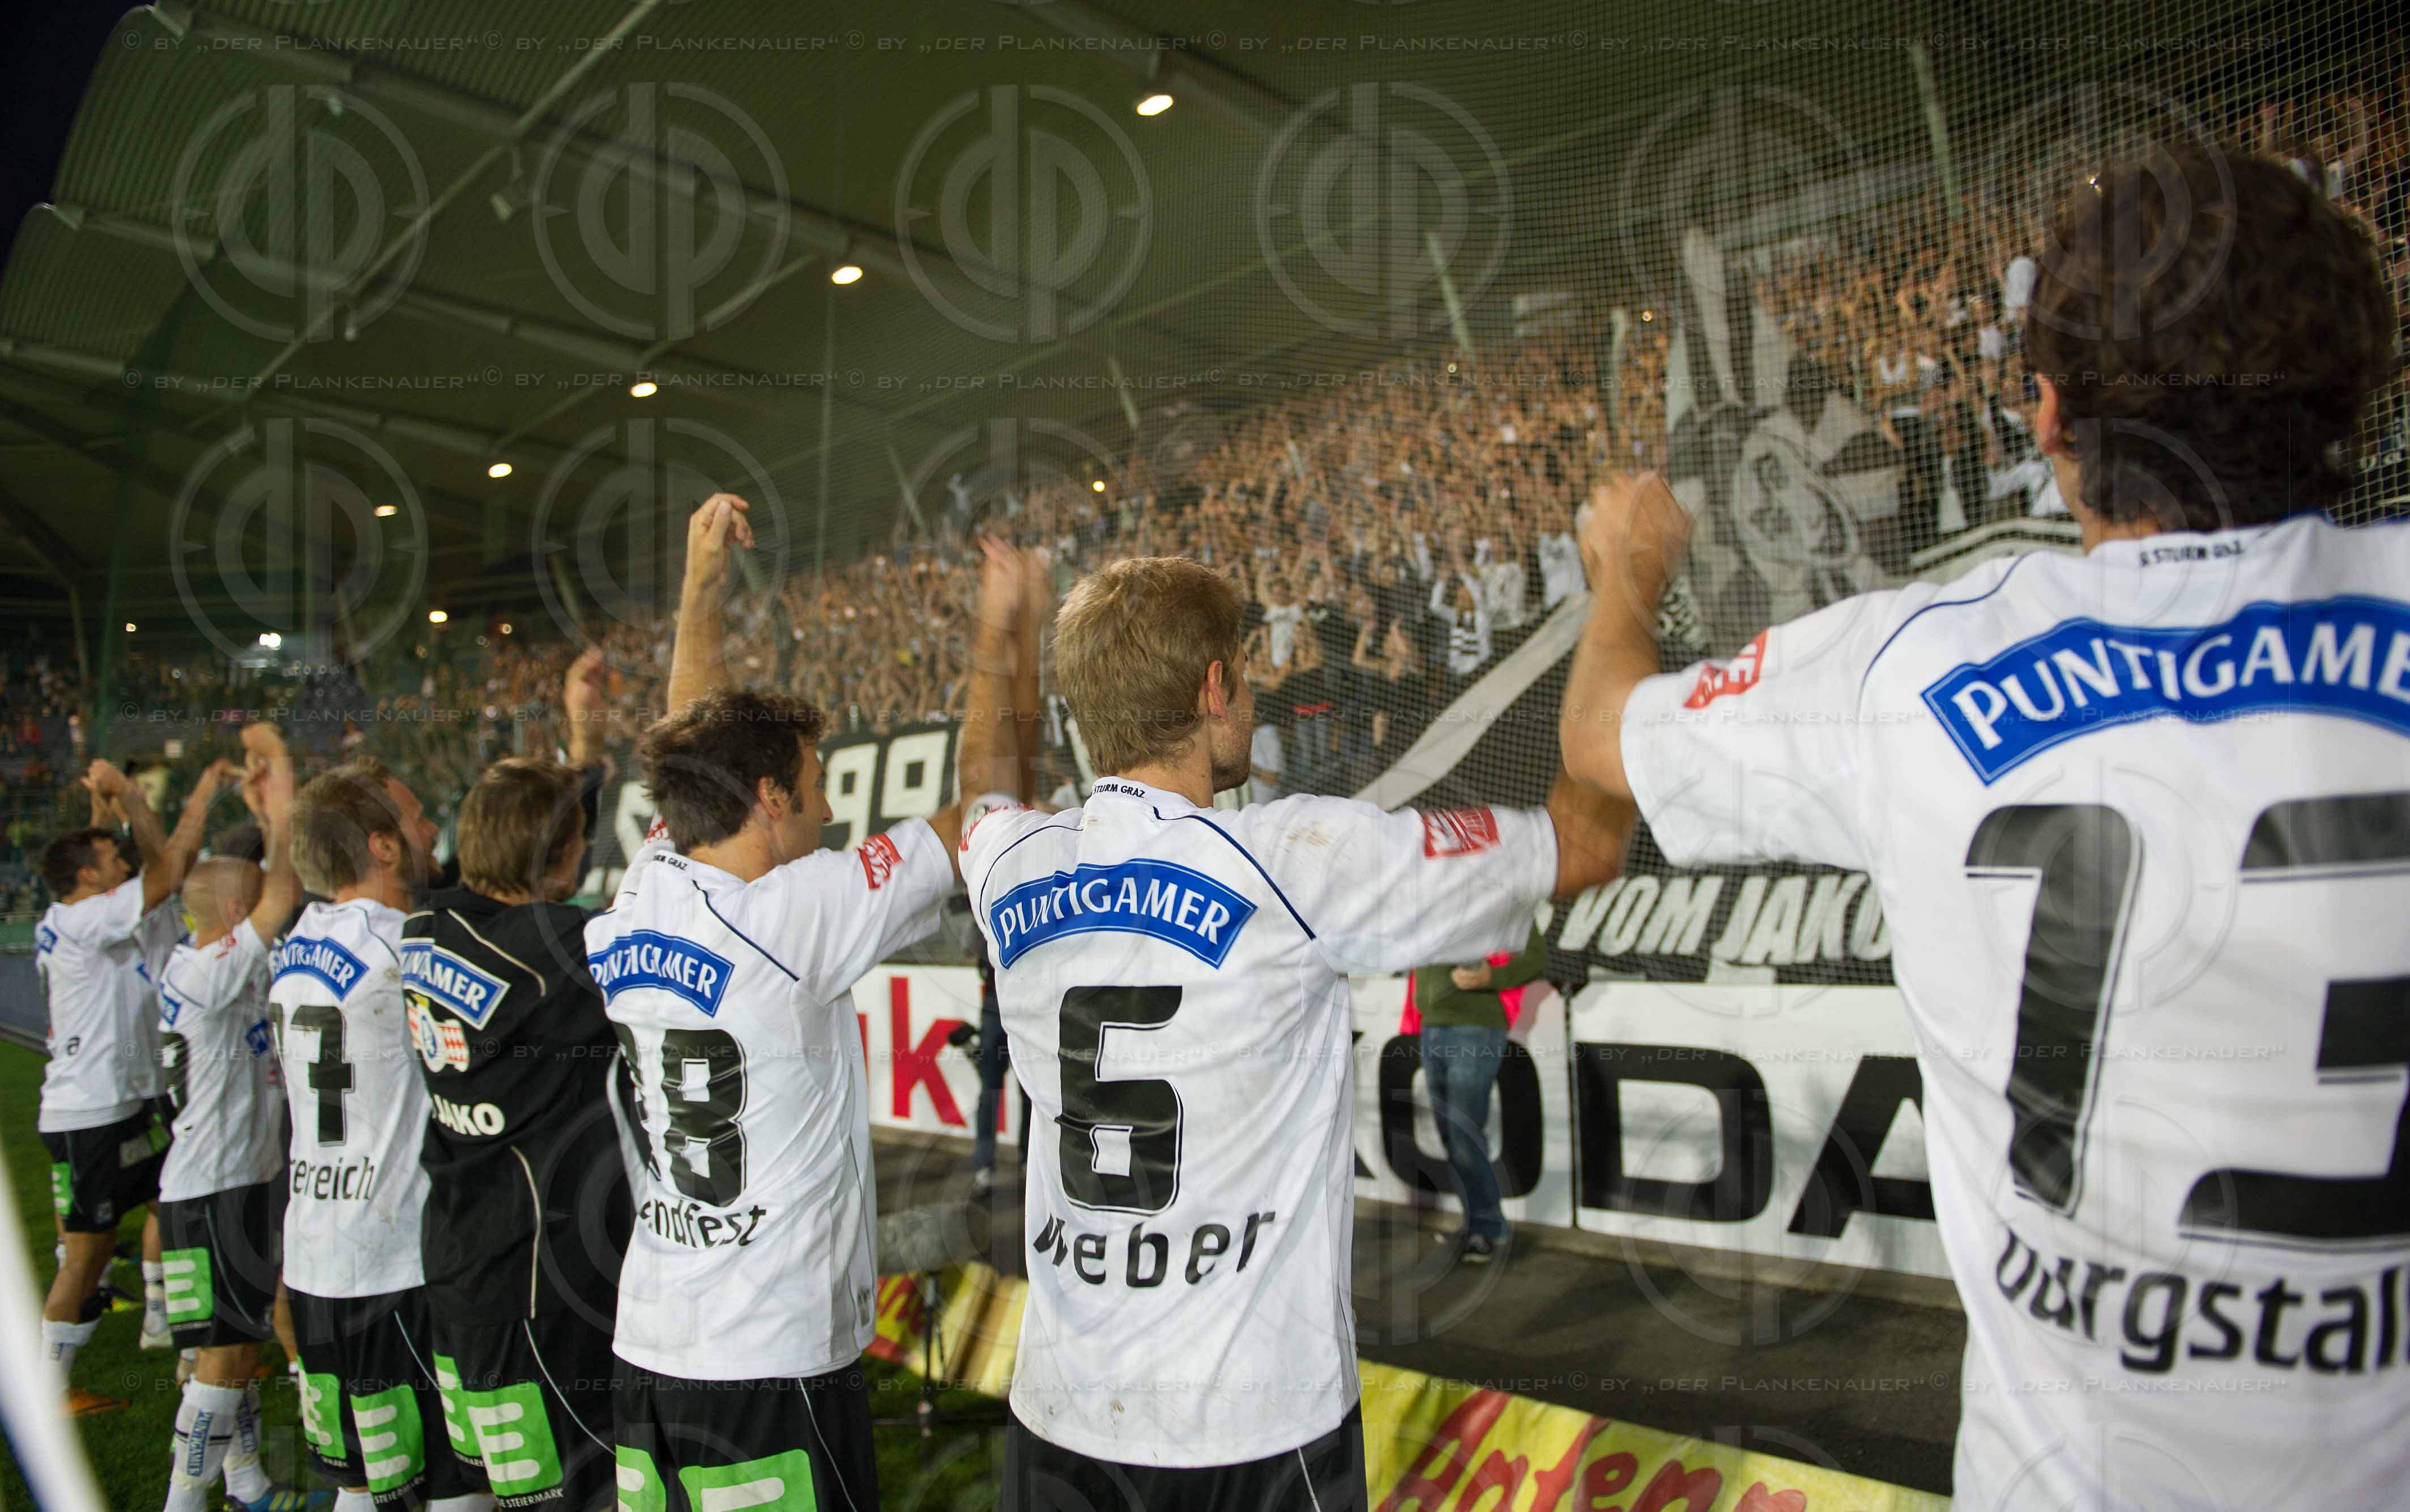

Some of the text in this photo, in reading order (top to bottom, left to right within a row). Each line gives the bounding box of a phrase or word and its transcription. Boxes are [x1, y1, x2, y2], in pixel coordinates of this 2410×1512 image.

[1093, 783, 1145, 798] STURM GRAZ
[999, 877, 1231, 949] PUNTIGAMER
[1556, 874, 1725, 956] VOM
[1055, 985, 1184, 1216] 6
[290, 1156, 376, 1201] ereich
